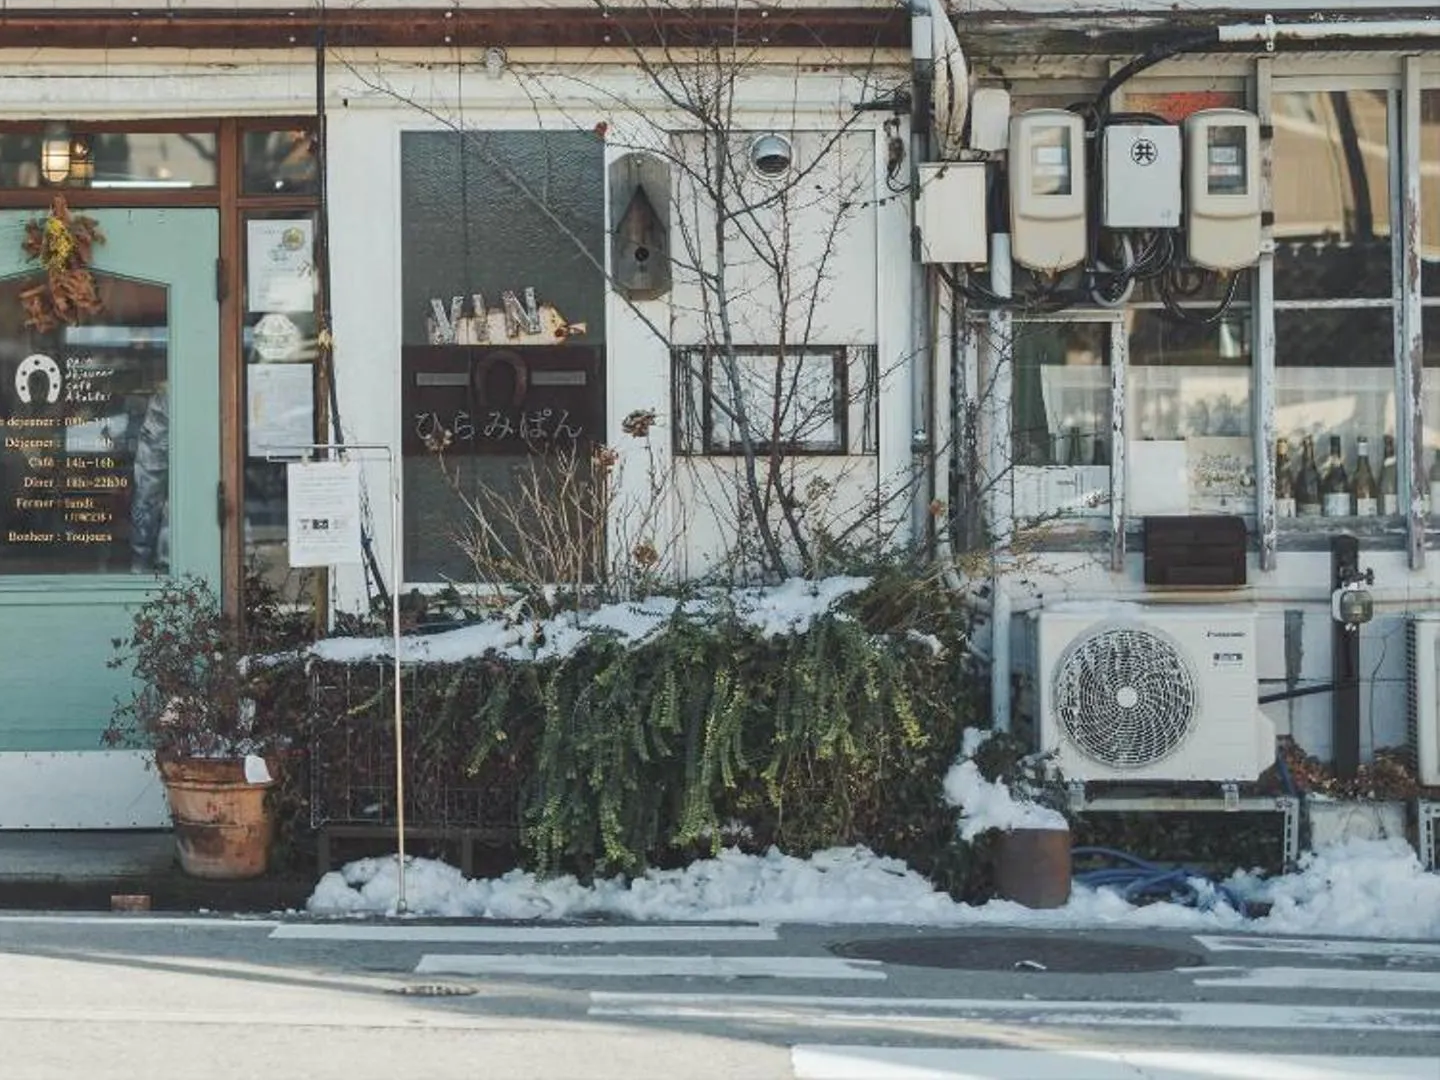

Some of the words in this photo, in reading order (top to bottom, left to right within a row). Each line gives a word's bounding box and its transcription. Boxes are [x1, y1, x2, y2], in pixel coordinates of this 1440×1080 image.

[415, 408, 583, 441] ひらみぱん
